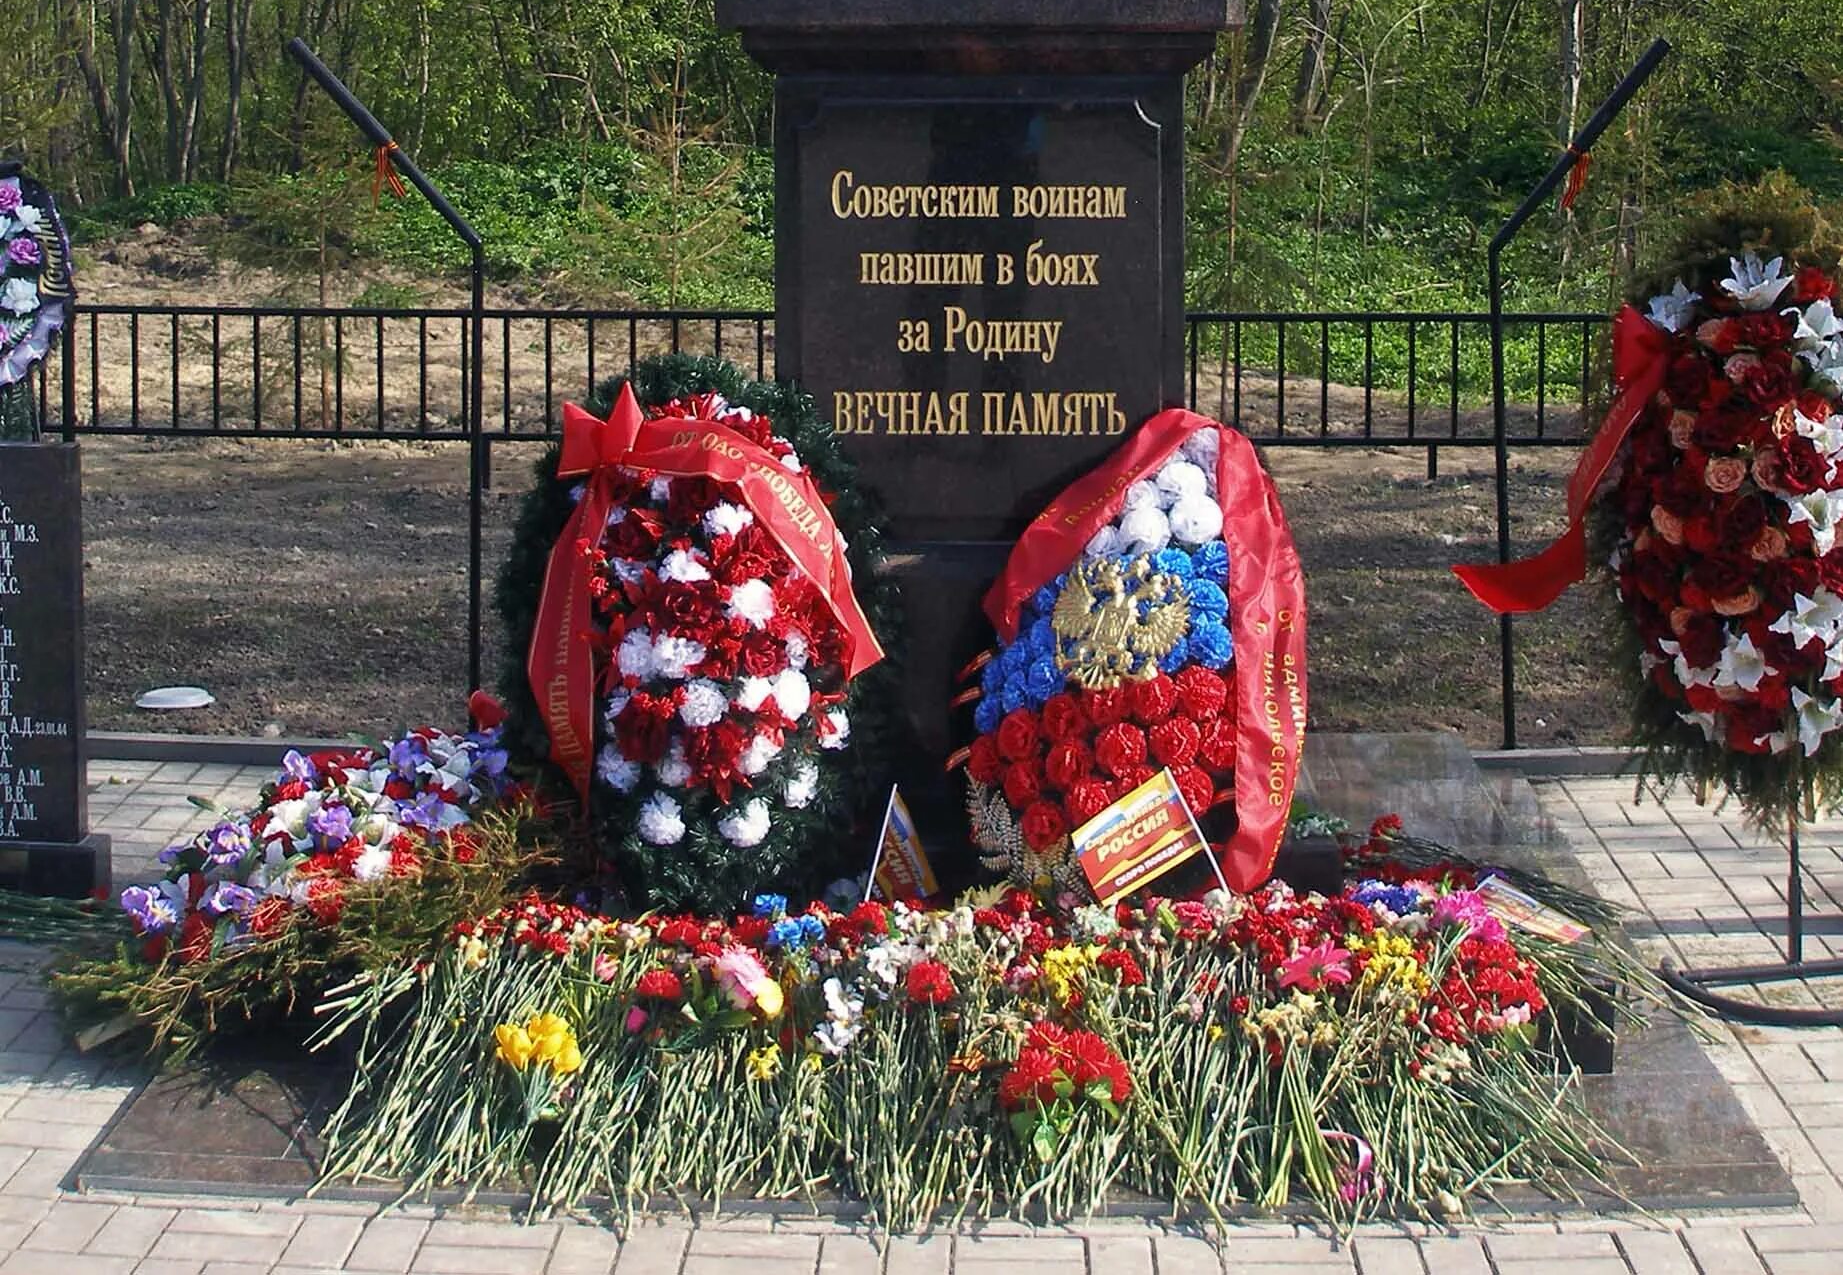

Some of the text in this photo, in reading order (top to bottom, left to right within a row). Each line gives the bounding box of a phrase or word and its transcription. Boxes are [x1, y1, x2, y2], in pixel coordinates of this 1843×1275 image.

[831, 170, 1127, 218] Советским воинам
[859, 239, 1100, 286] павшим в боях
[897, 306, 1063, 363] за Родину
[832, 391, 1127, 437] ВЕЧНАЯ ПАМЯТЬ
[701, 432, 745, 461] ОАО
[1096, 808, 1169, 863] РОССИЯ
